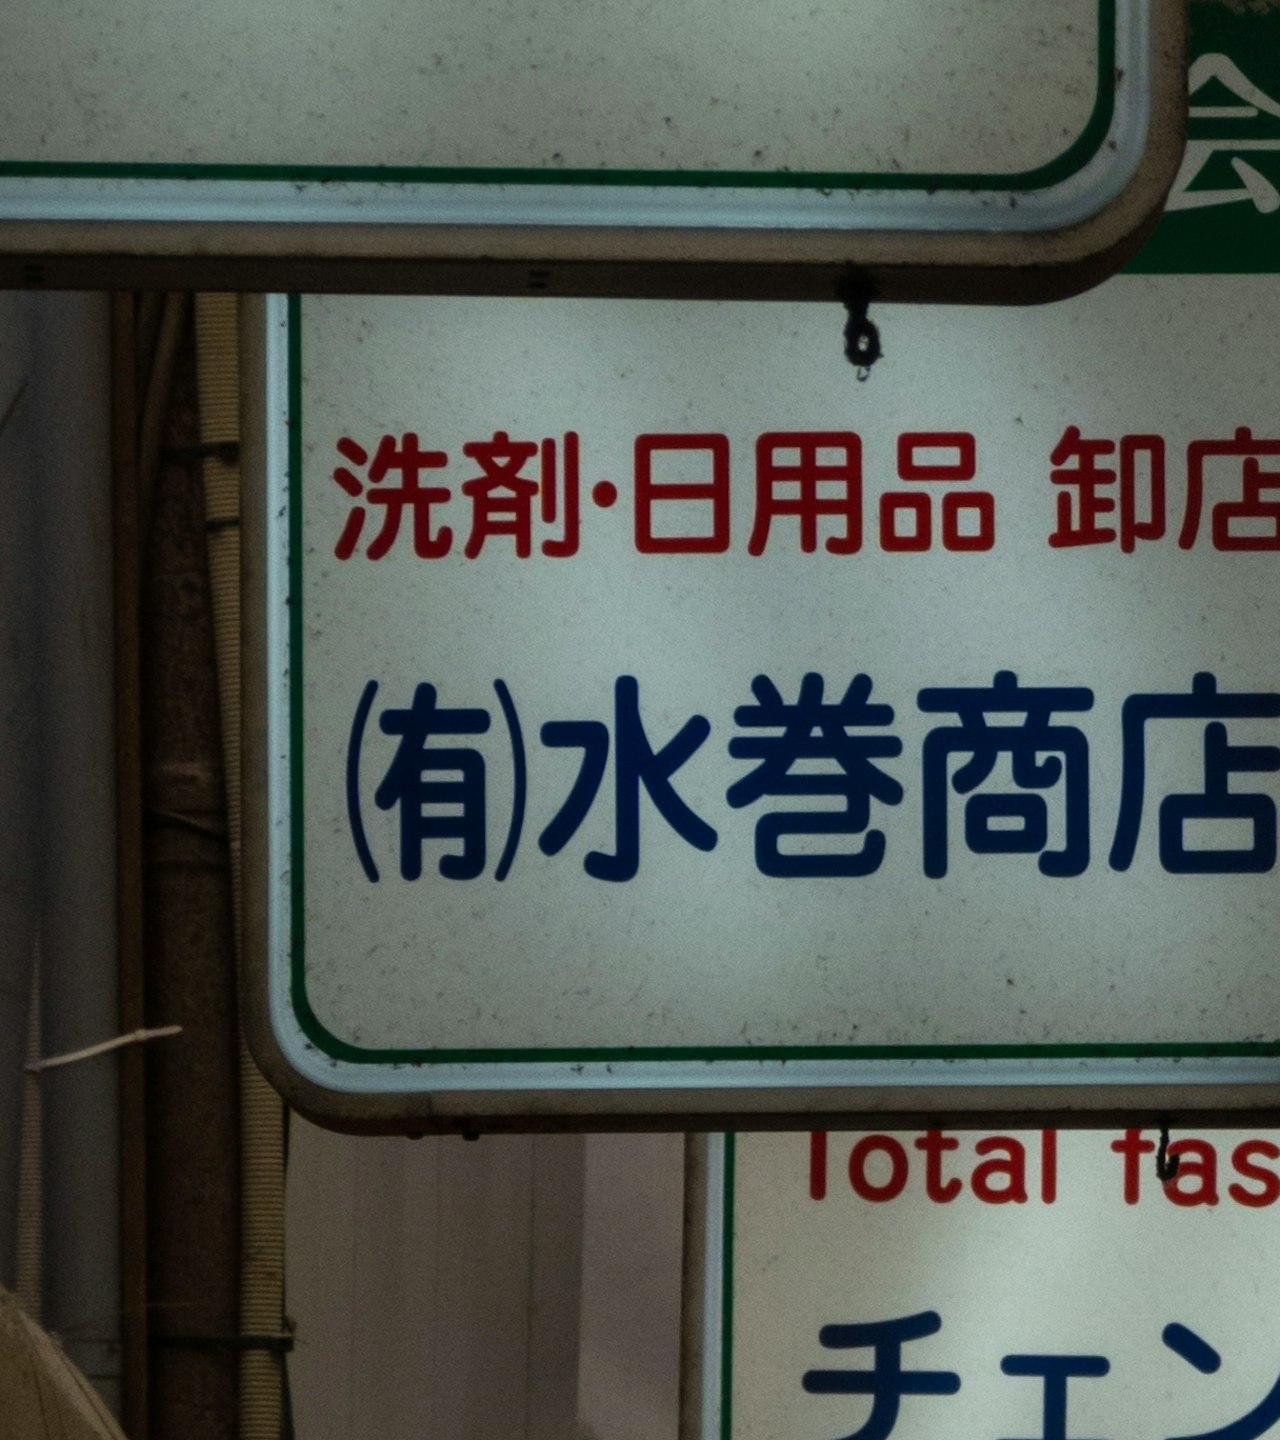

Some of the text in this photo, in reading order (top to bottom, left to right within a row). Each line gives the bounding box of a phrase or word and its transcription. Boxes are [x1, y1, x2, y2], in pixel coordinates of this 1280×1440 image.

[332, 430, 996, 561] 洗剤・日用品
[804, 1126, 1058, 1205] Total
